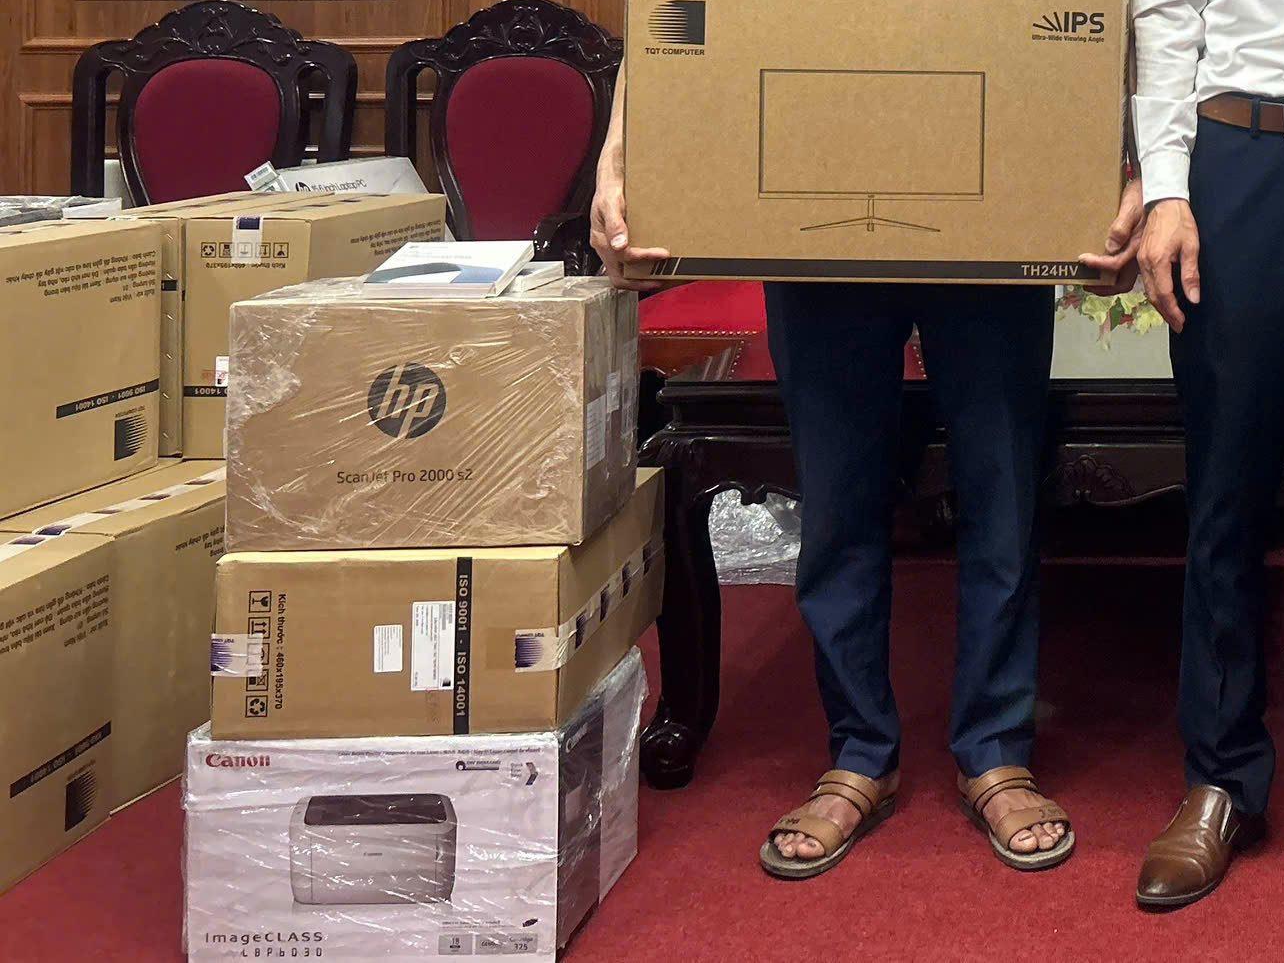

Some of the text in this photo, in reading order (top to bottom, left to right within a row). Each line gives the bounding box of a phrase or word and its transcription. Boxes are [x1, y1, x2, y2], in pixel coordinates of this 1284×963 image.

[1064, 12, 1104, 33] IPS
[1021, 265, 1078, 276] TH24HV
[96, 396, 108, 405] ISO
[135, 386, 145, 395] ISO
[75, 400, 94, 411] 14001
[376, 365, 439, 439] hp
[337, 468, 473, 483] ScanJet Pro 2000 s2
[459, 575, 468, 596] ISO
[277, 594, 286, 614] Kích
[458, 600, 468, 631] 9001
[277, 617, 285, 644] thước
[458, 652, 466, 674] ISO
[275, 652, 284, 709] 460x195x370
[456, 679, 466, 716] 14001
[206, 754, 270, 767] Canon
[206, 932, 323, 945] imageCLASS
[242, 948, 322, 957] LBP6030
